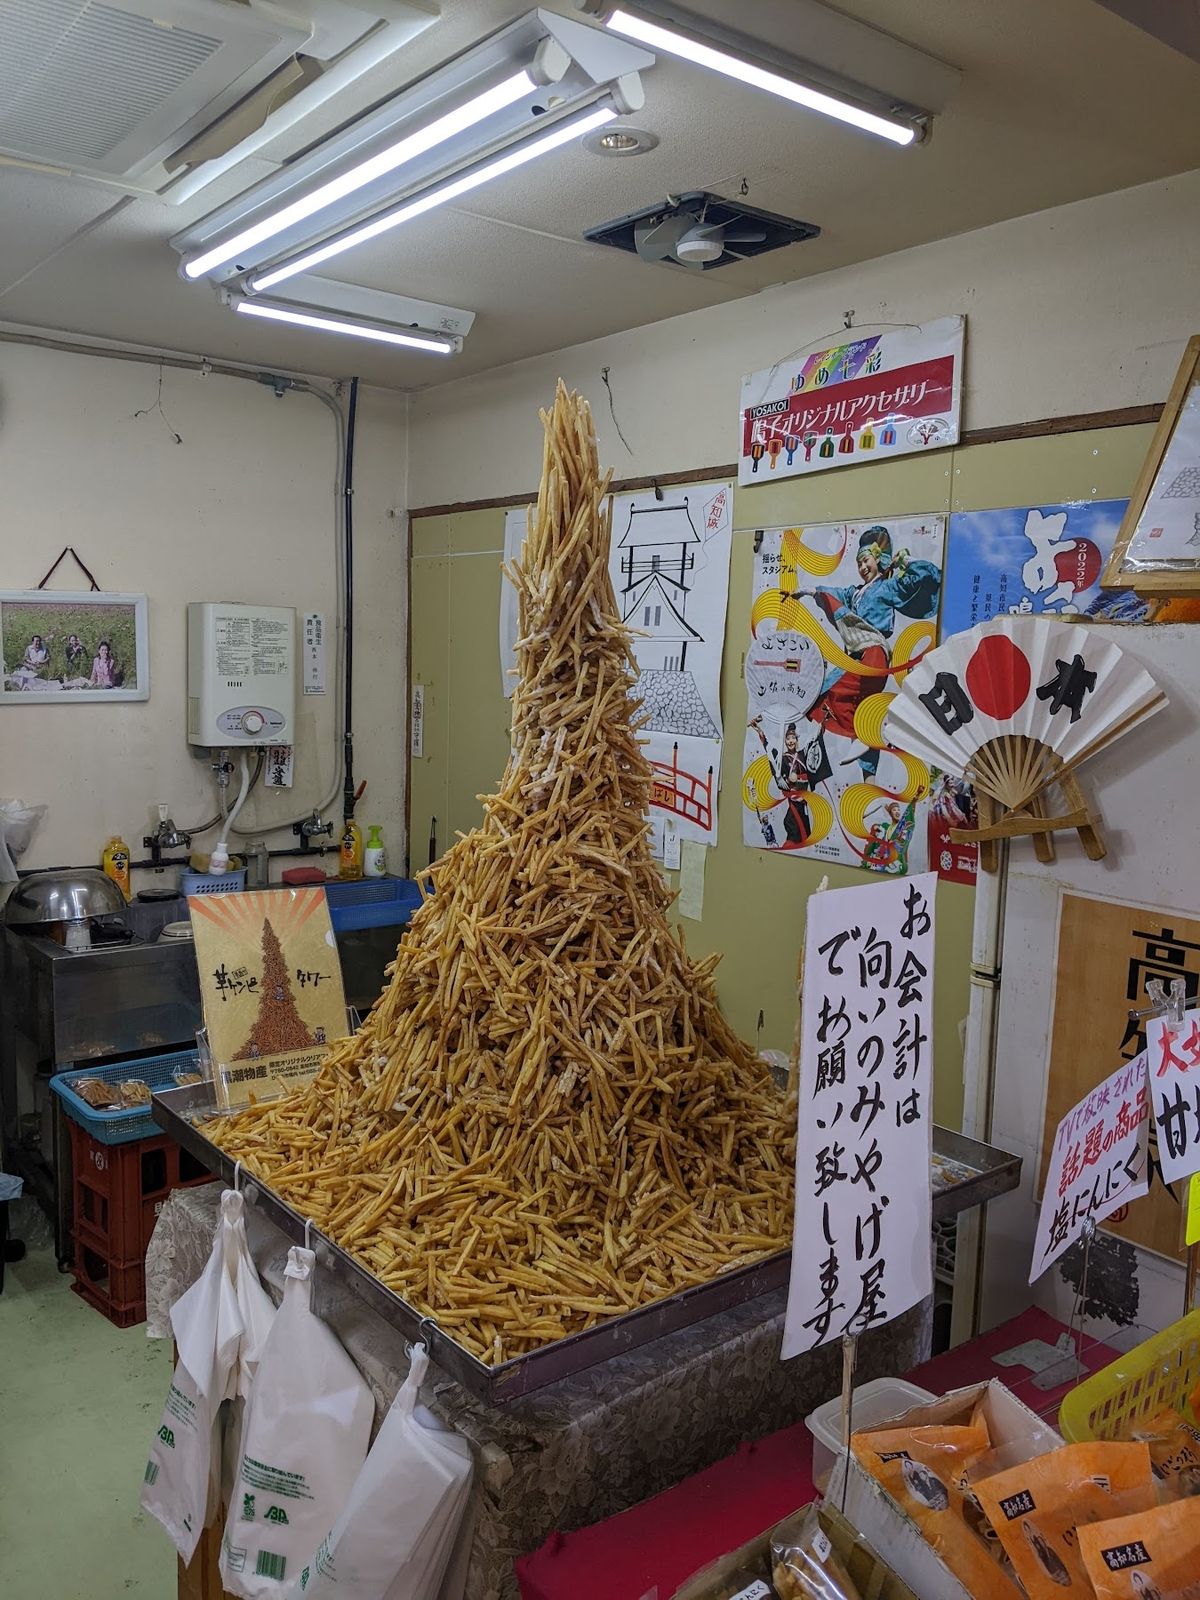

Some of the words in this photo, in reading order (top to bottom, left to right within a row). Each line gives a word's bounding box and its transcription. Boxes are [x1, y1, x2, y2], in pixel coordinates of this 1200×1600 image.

[752, 400, 788, 418] YOSAKOI
[1077, 542, 1088, 587] 2022年
[893, 883, 932, 1127] お会計は
[802, 925, 861, 1350] でお願い致します
[840, 927, 893, 1333] 向いのみやげ屋
[1058, 1085, 1149, 1197] 話題の商品
[1041, 1143, 1141, 1265] 塩にんにく
[1106, 1543, 1148, 1568] 高知名産
